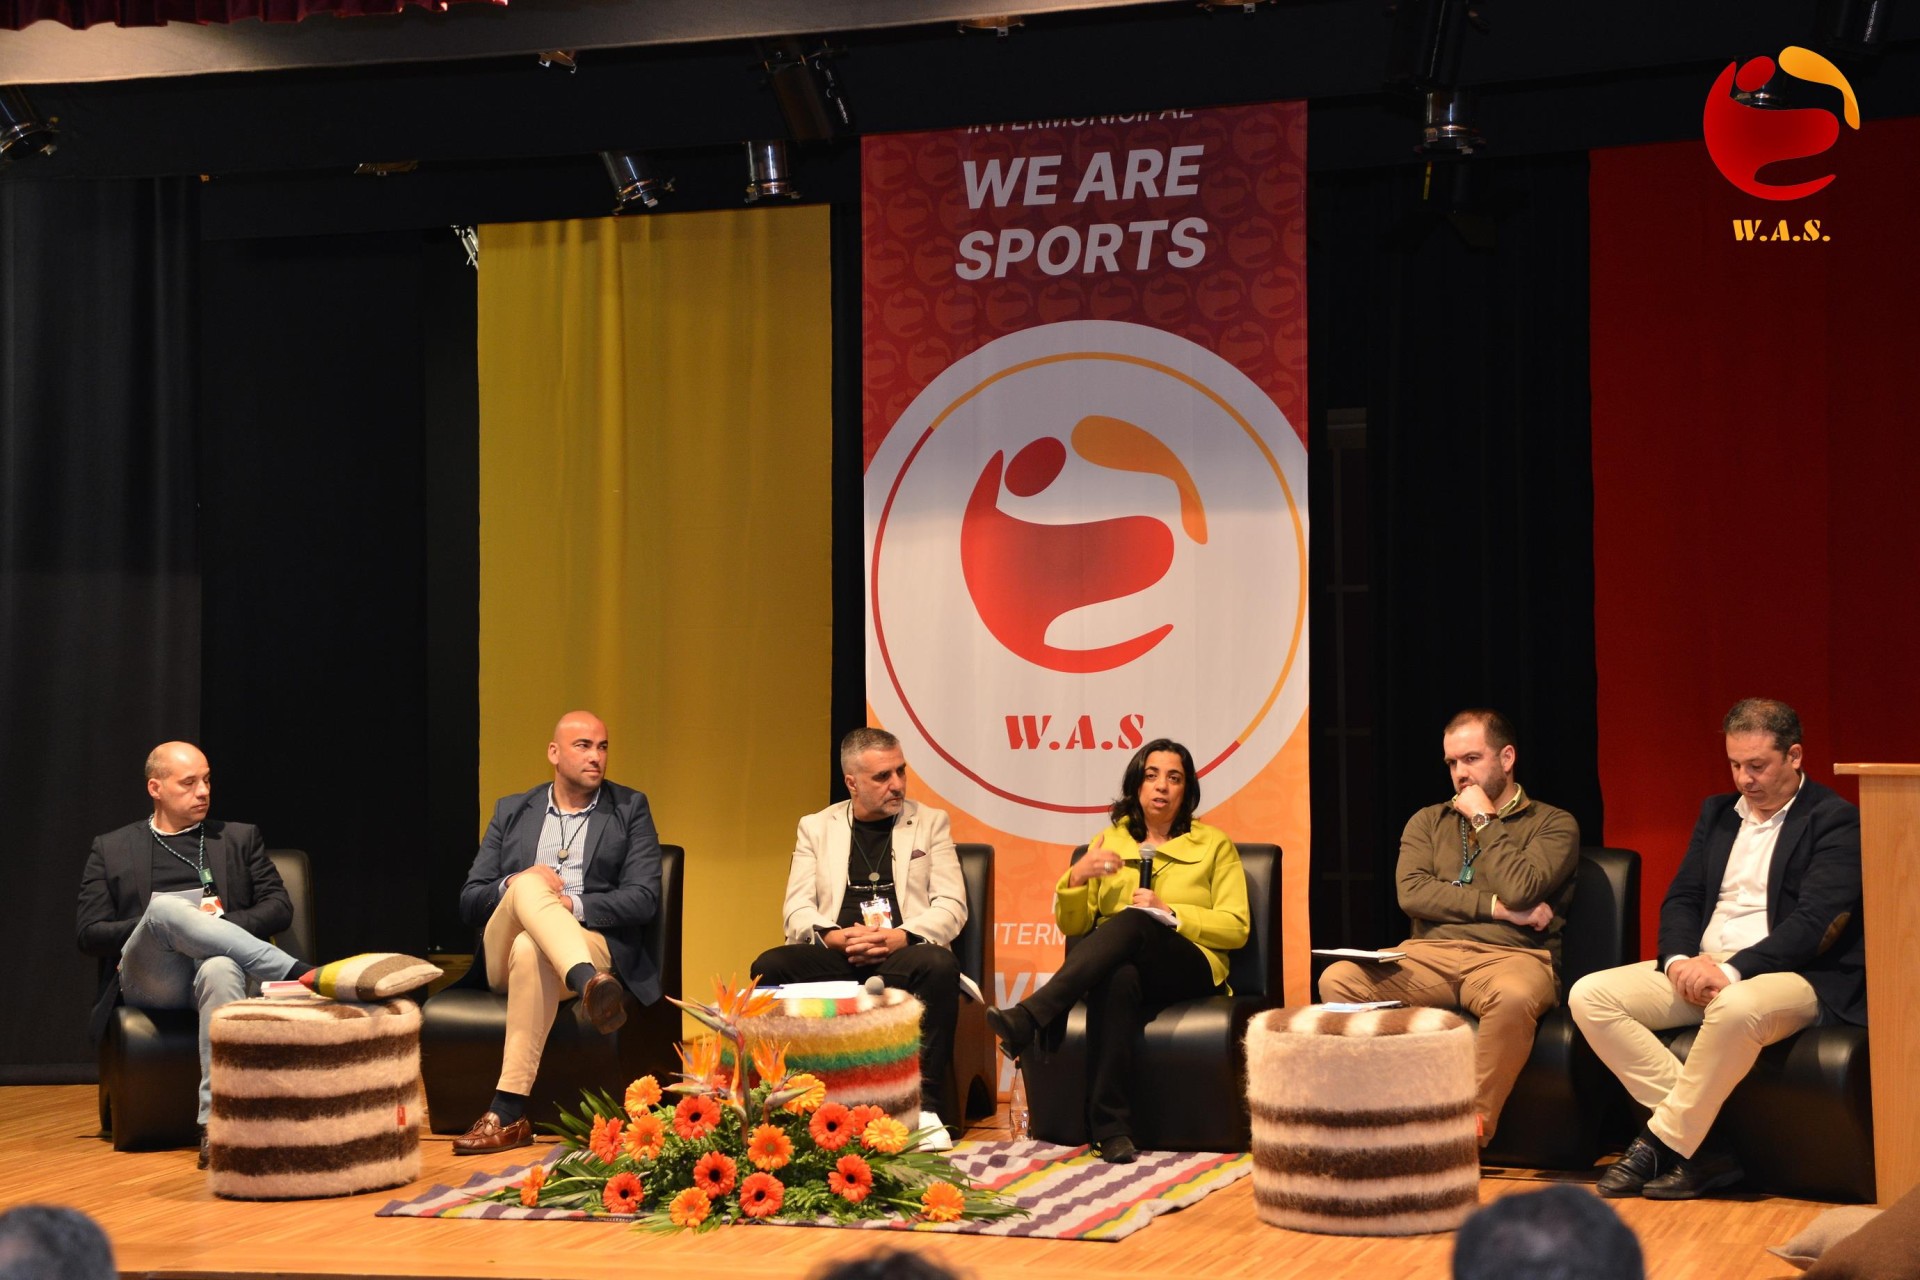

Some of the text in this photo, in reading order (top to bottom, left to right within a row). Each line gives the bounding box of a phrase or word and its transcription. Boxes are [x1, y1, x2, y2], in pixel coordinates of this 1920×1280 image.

[962, 144, 1205, 210] WE ARE
[955, 216, 1209, 281] SPORTS
[1004, 713, 1145, 751] W.A.S
